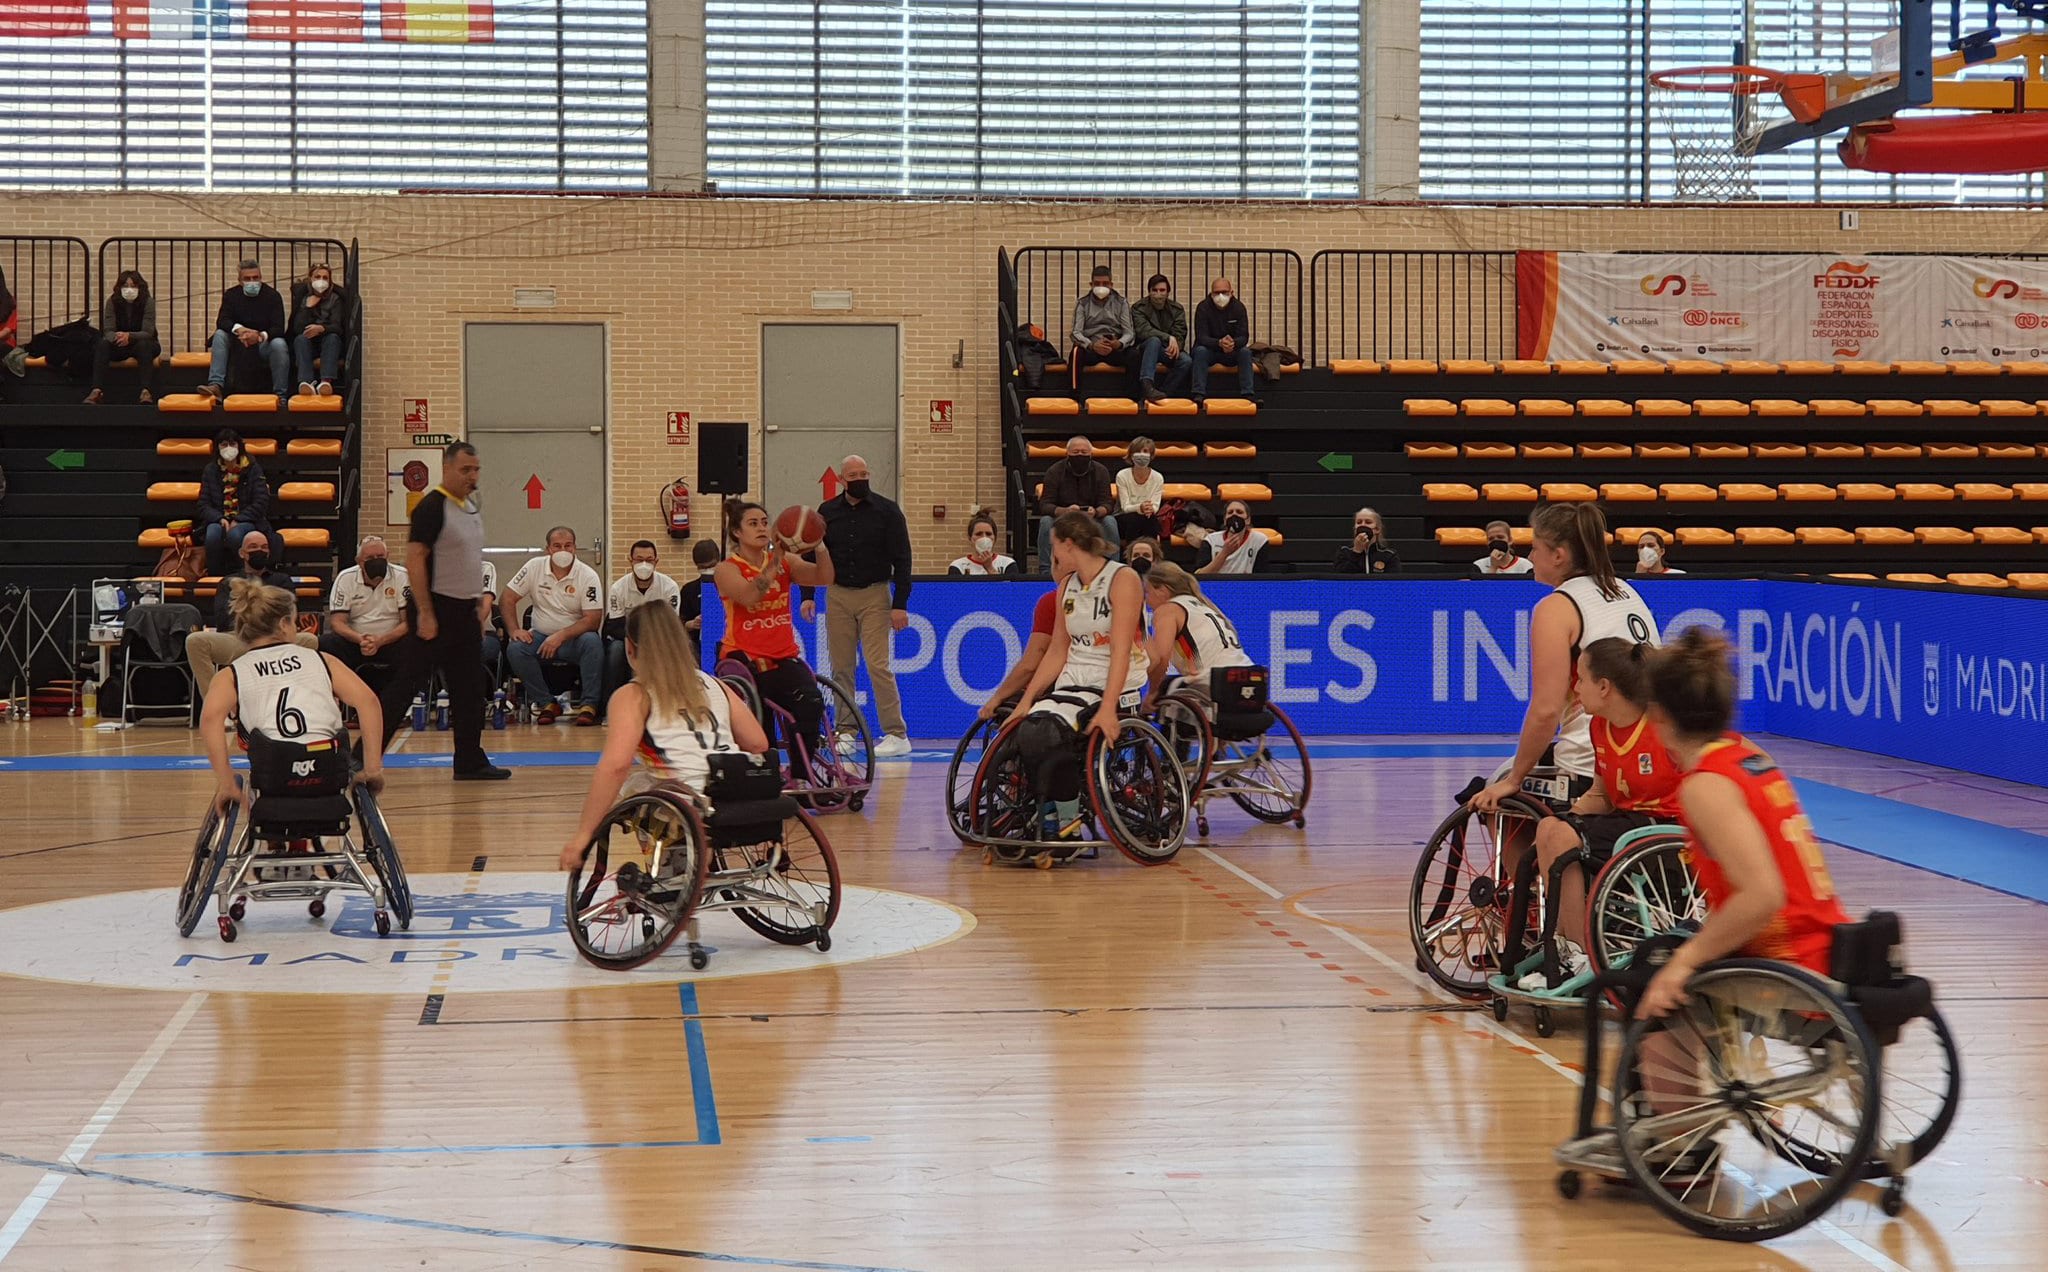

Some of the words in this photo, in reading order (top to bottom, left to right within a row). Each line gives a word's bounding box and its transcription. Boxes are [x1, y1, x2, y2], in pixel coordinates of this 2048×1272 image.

[1814, 275, 1880, 288] FEDDF
[1817, 290, 1875, 300] FEDERACIÓN
[1821, 300, 1870, 309] ESPAÑOLA
[1825, 310, 1873, 319] DEPORTES
[1621, 316, 1658, 326] CaixaBank
[1710, 317, 1740, 325] ONCE
[1817, 320, 1867, 328] PERSONAS
[1812, 329, 1880, 338] DISCAPACIDAD
[1831, 338, 1861, 347] FÍSICA
[414, 435, 446, 445] SALIDA
[1093, 597, 1110, 620] 14
[742, 611, 791, 631] endes
[254, 655, 302, 677] WEISS
[1432, 601, 1901, 723] INRACIÓN
[1956, 653, 2046, 722] MADRI
[276, 686, 307, 738] 6
[172, 944, 719, 967] MADRD
